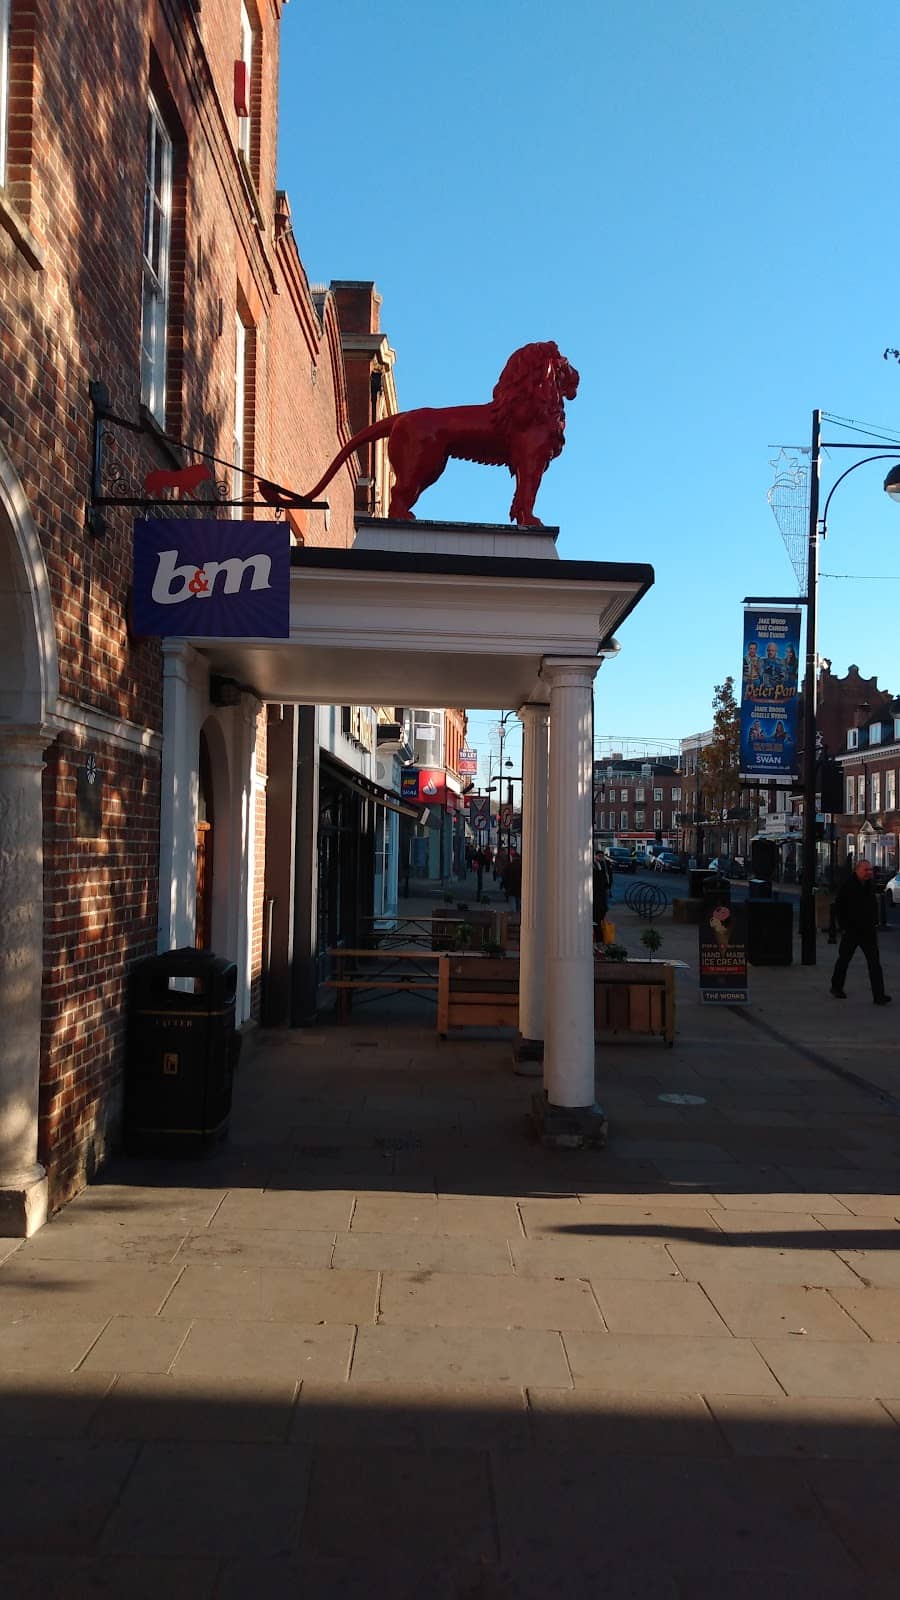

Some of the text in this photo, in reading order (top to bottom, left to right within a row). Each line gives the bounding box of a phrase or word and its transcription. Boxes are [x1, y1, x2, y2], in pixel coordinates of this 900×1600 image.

[152, 549, 273, 605] b&m
[745, 683, 796, 700] Peter Pan
[755, 756, 781, 764] SWAN
[702, 958, 746, 966] ICE CREAM
